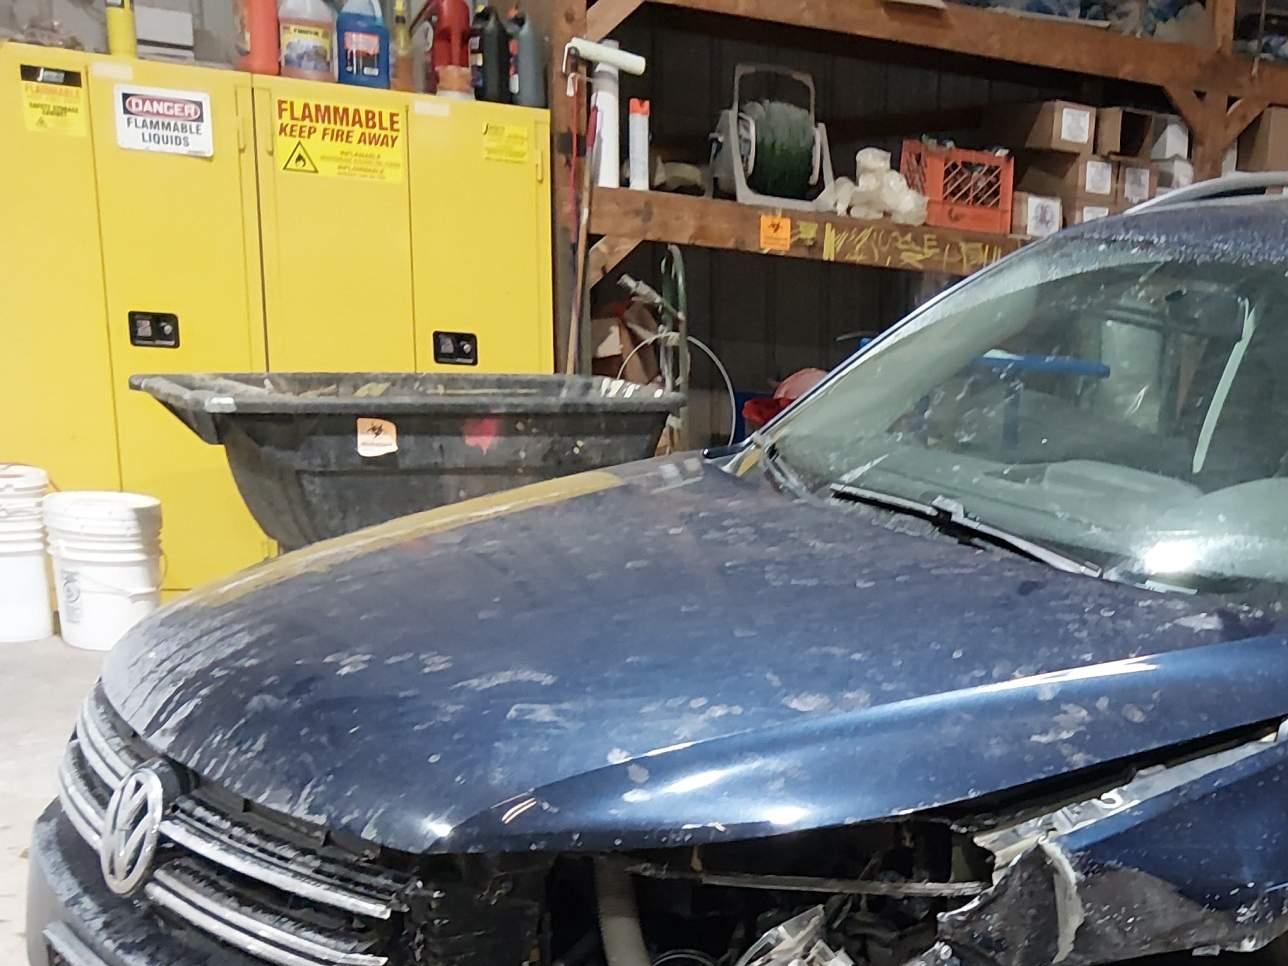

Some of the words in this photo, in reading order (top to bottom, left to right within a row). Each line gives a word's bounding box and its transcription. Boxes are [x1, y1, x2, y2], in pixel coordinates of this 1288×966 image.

[131, 99, 195, 118] DANGER
[277, 99, 400, 132] FLAMMABLE
[126, 117, 203, 135] FLAMMABLE
[278, 123, 317, 139] KEEP
[321, 127, 354, 144] FIRE
[357, 131, 399, 148] AWAY
[141, 132, 190, 147] LIQUIDS
